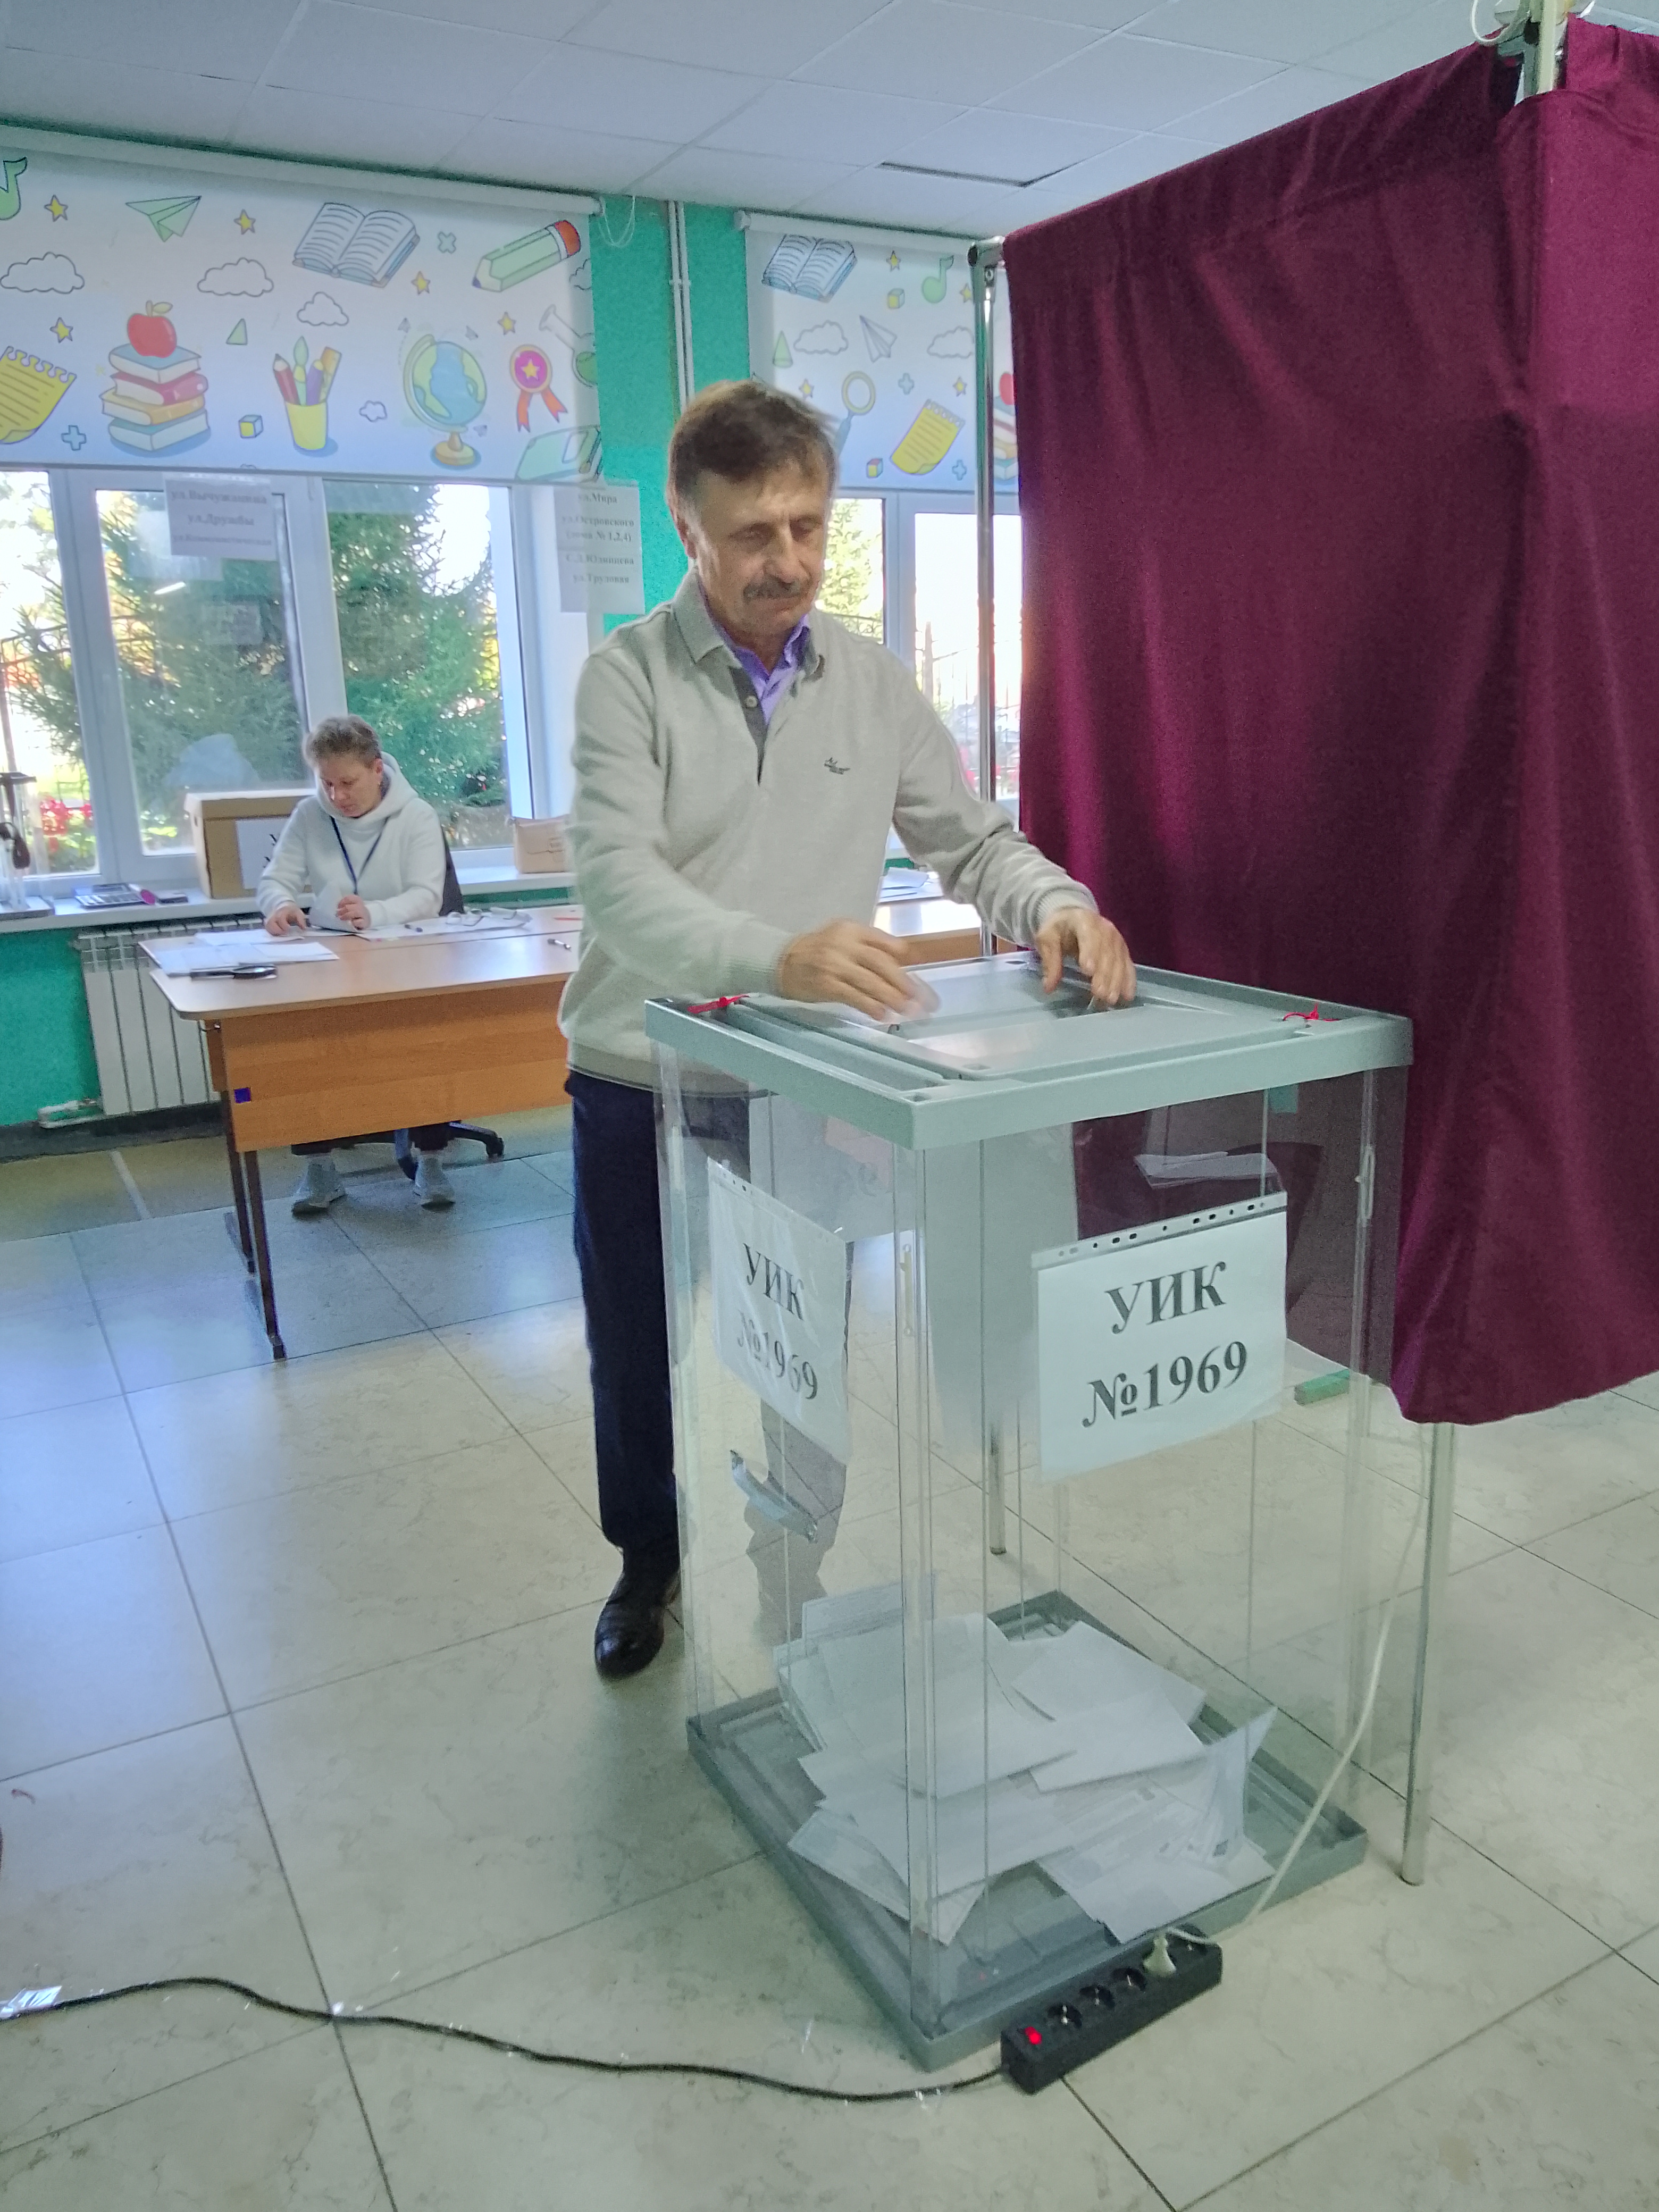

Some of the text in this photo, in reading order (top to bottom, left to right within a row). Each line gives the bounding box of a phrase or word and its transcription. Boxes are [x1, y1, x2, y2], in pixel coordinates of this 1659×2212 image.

[743, 1242, 805, 1321] УИК
[1104, 1261, 1227, 1335] УИК
[736, 1308, 818, 1400] №1969
[1081, 1341, 1248, 1428] №1969
